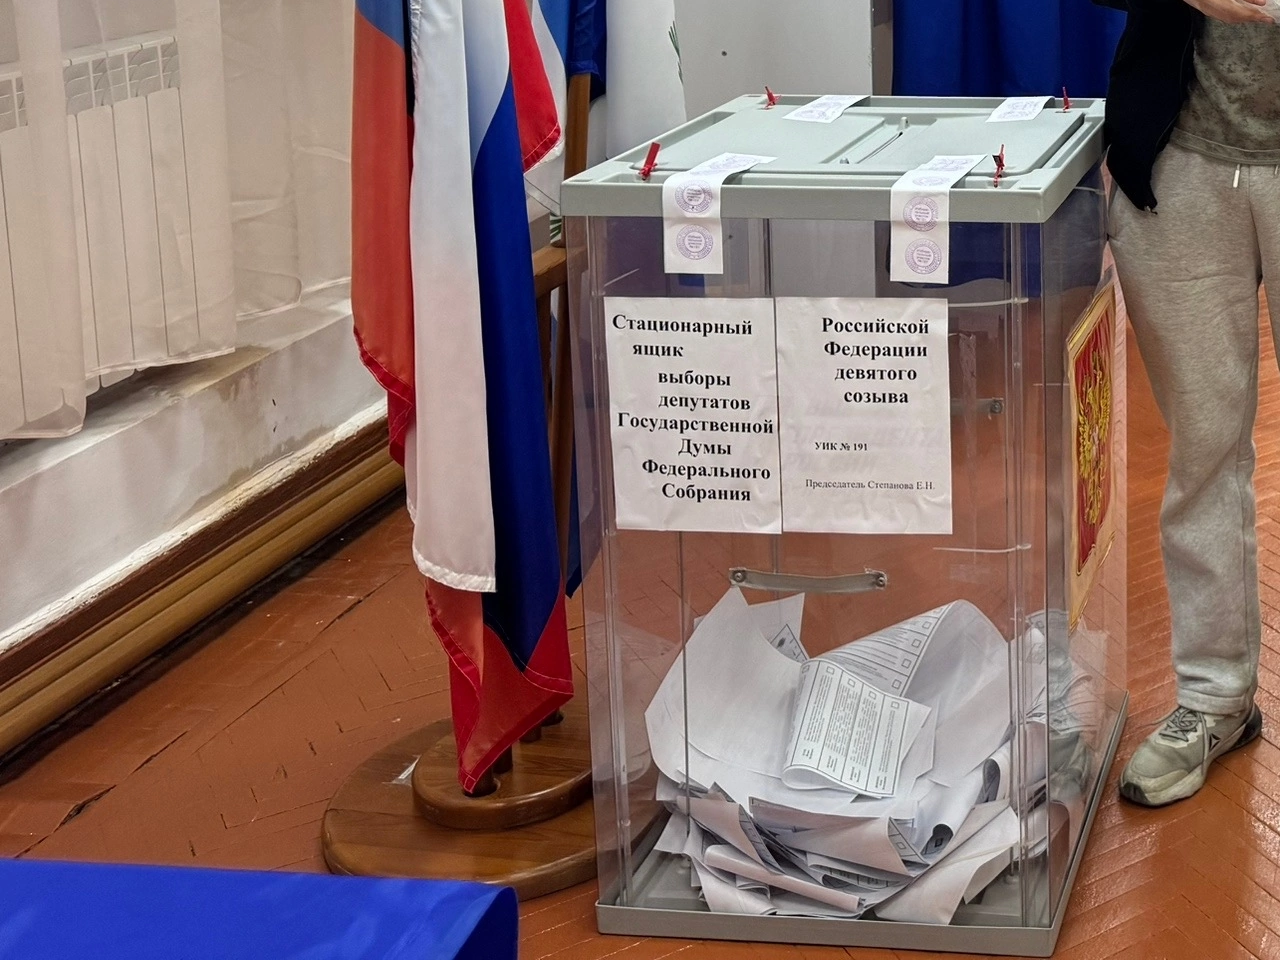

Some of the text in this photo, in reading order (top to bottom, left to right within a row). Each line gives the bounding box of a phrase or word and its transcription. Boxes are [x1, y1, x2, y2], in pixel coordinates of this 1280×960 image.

[612, 314, 752, 338] Стационарный
[821, 317, 929, 335] Российской
[632, 344, 684, 358] ящик
[823, 341, 928, 360] Федерации
[658, 370, 731, 390] выборы
[834, 368, 918, 381] девятого
[658, 395, 751, 411] депутатов
[843, 391, 909, 404] созыва
[617, 411, 774, 435] Государственной
[677, 438, 732, 457] Думы
[814, 441, 868, 451] УИК № 191
[642, 458, 771, 480] Федерального
[662, 483, 751, 502] Собрания
[805, 478, 936, 491] Председатель Степанова Е.Н.
